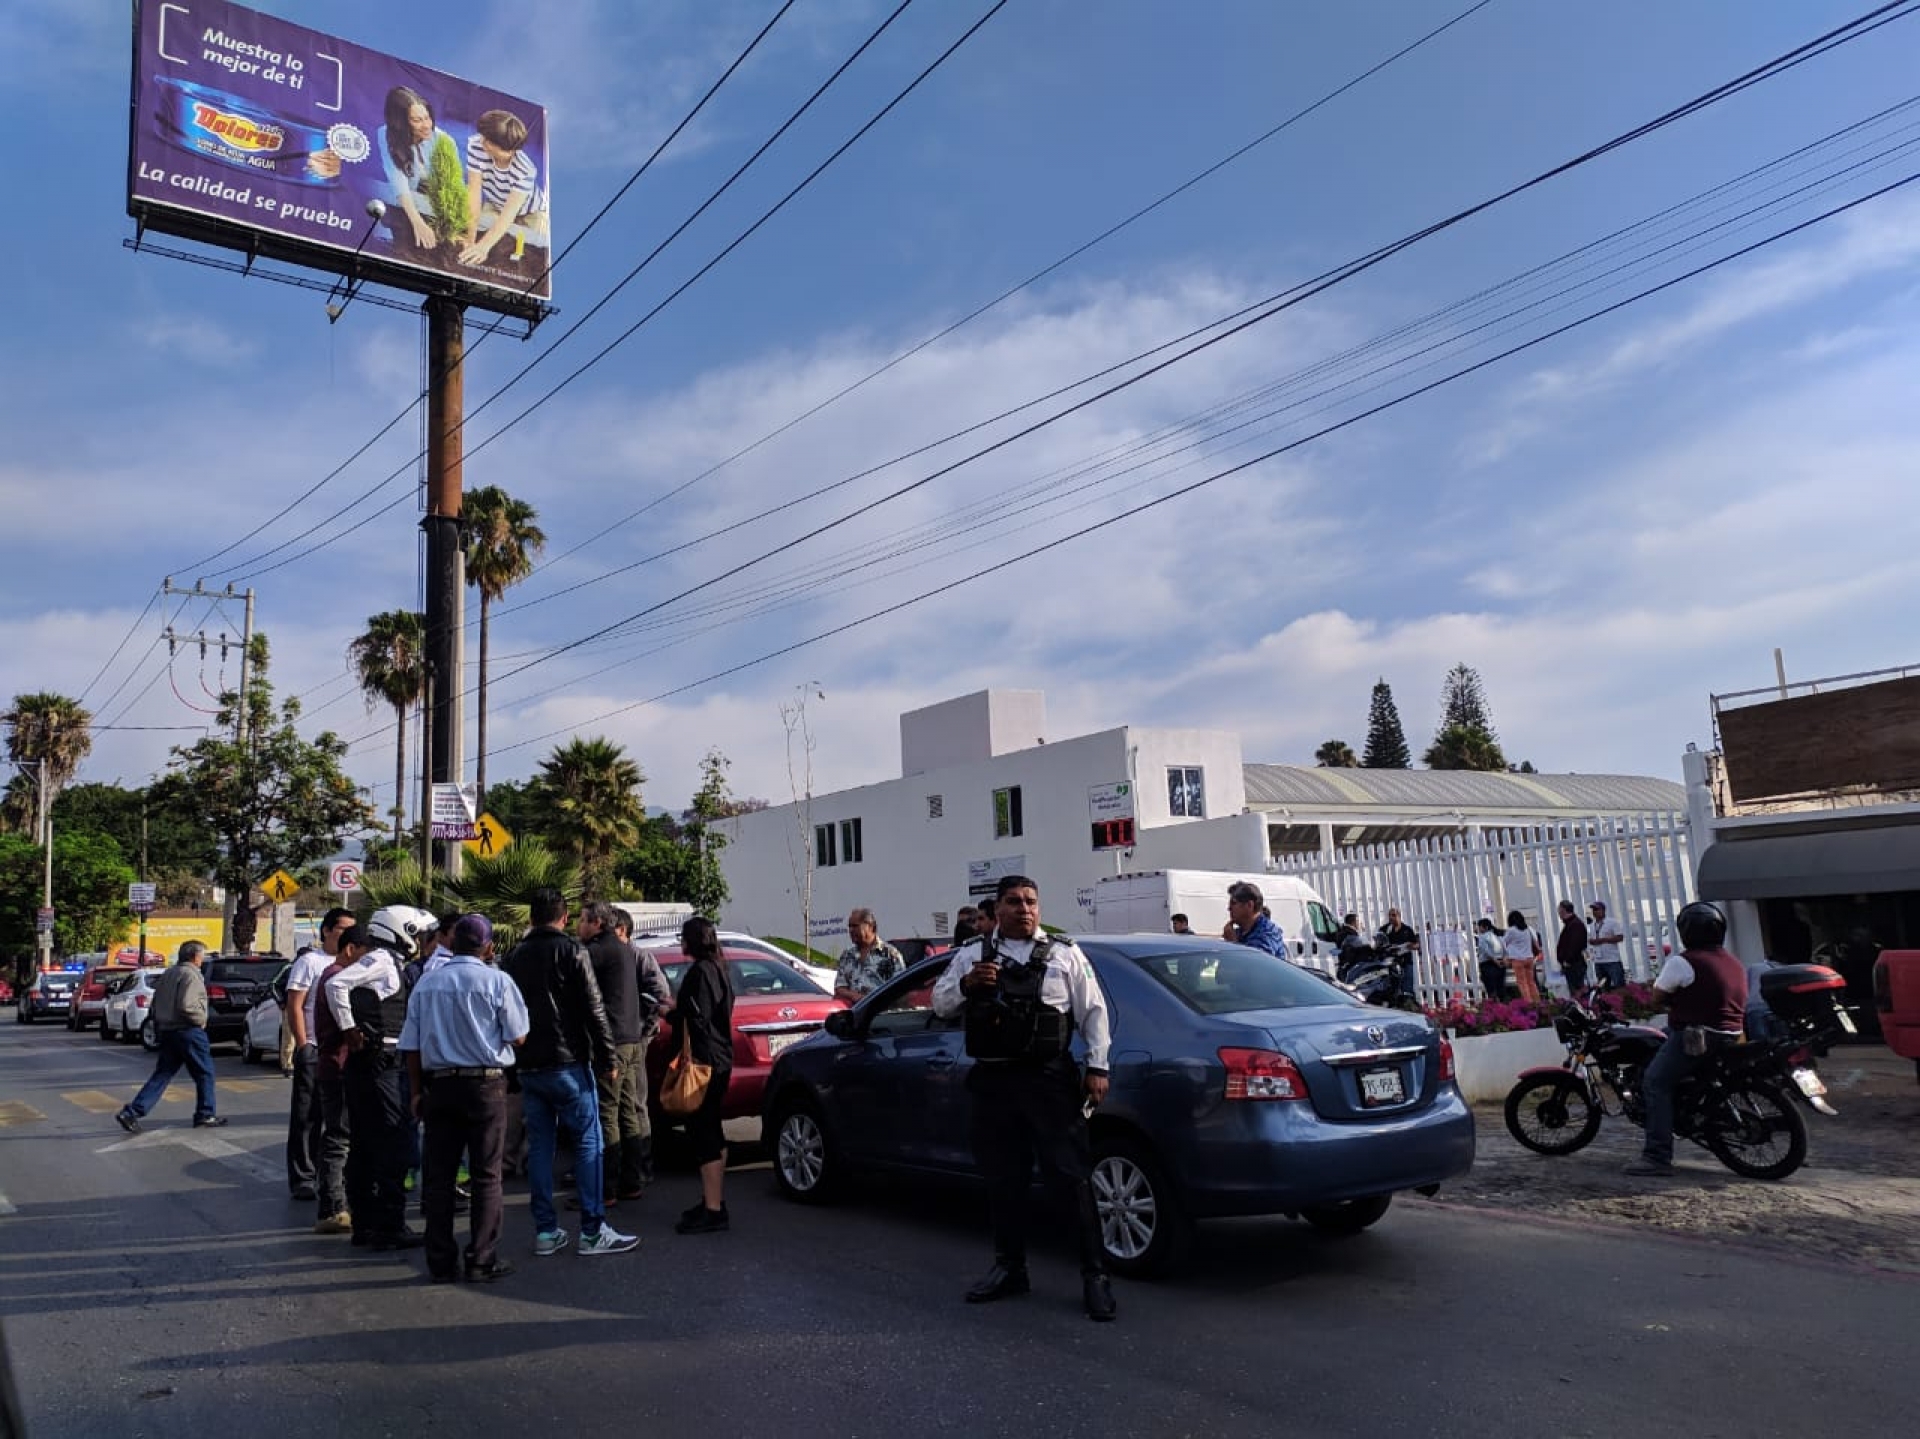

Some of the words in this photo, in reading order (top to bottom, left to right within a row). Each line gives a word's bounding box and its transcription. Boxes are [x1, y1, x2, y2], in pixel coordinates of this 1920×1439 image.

[203, 27, 282, 65] Muestra
[286, 53, 304, 71] lo
[203, 48, 260, 75] mejor
[262, 66, 285, 84] de
[289, 74, 304, 89] ti
[196, 105, 281, 149] Dolores
[248, 155, 276, 171] AGUA
[138, 161, 165, 182] La
[170, 169, 250, 205] calidad
[255, 195, 277, 212] se
[280, 203, 353, 232] prueba
[340, 869, 352, 884] E
